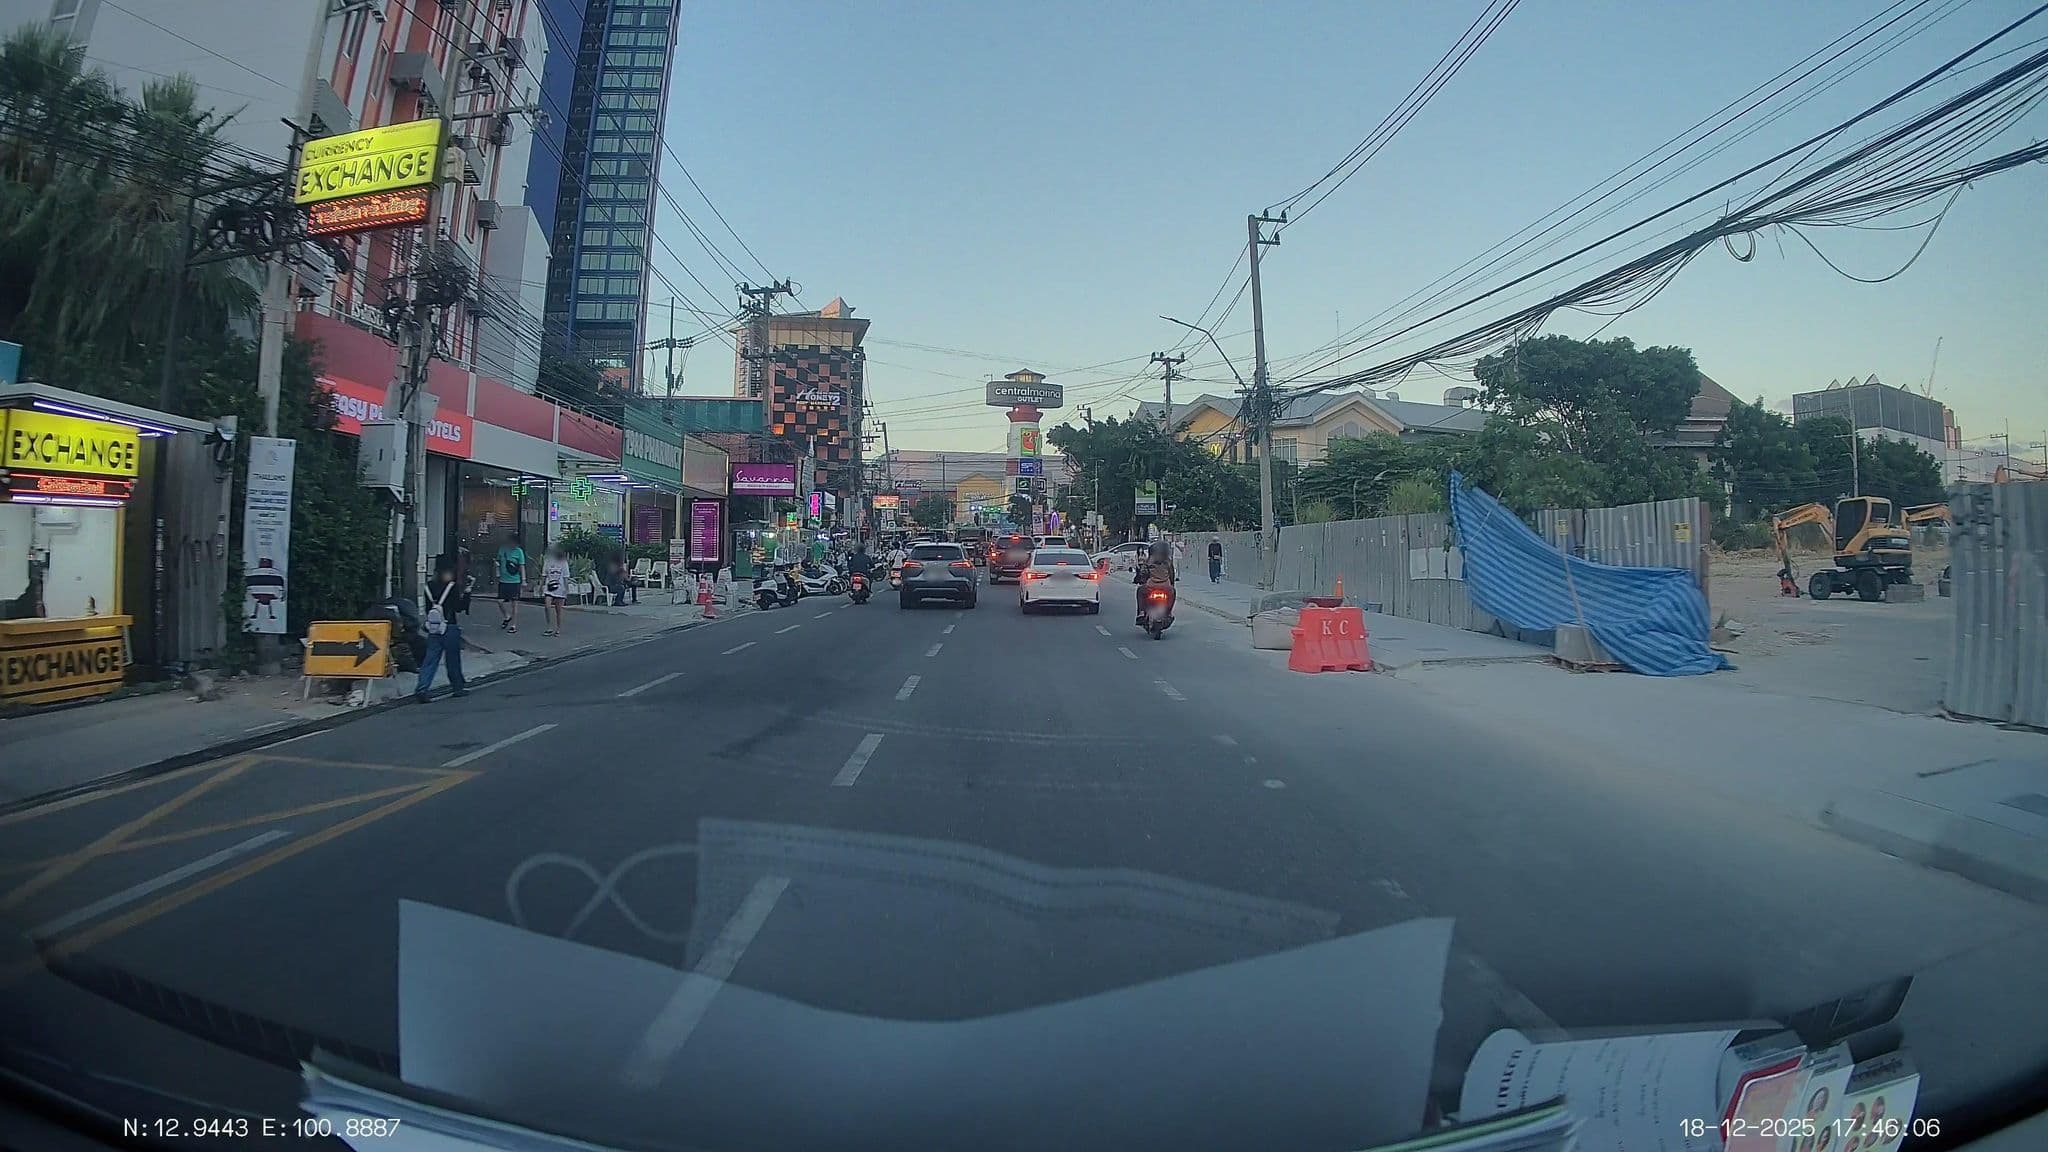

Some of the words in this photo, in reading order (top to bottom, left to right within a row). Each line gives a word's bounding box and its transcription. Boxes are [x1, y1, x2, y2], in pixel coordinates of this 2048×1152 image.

[305, 137, 374, 161] CURRENCY
[300, 150, 429, 196] EXCHANGE
[12, 429, 133, 469] EXCHANGE
[7, 646, 120, 685] EXCHANGE
